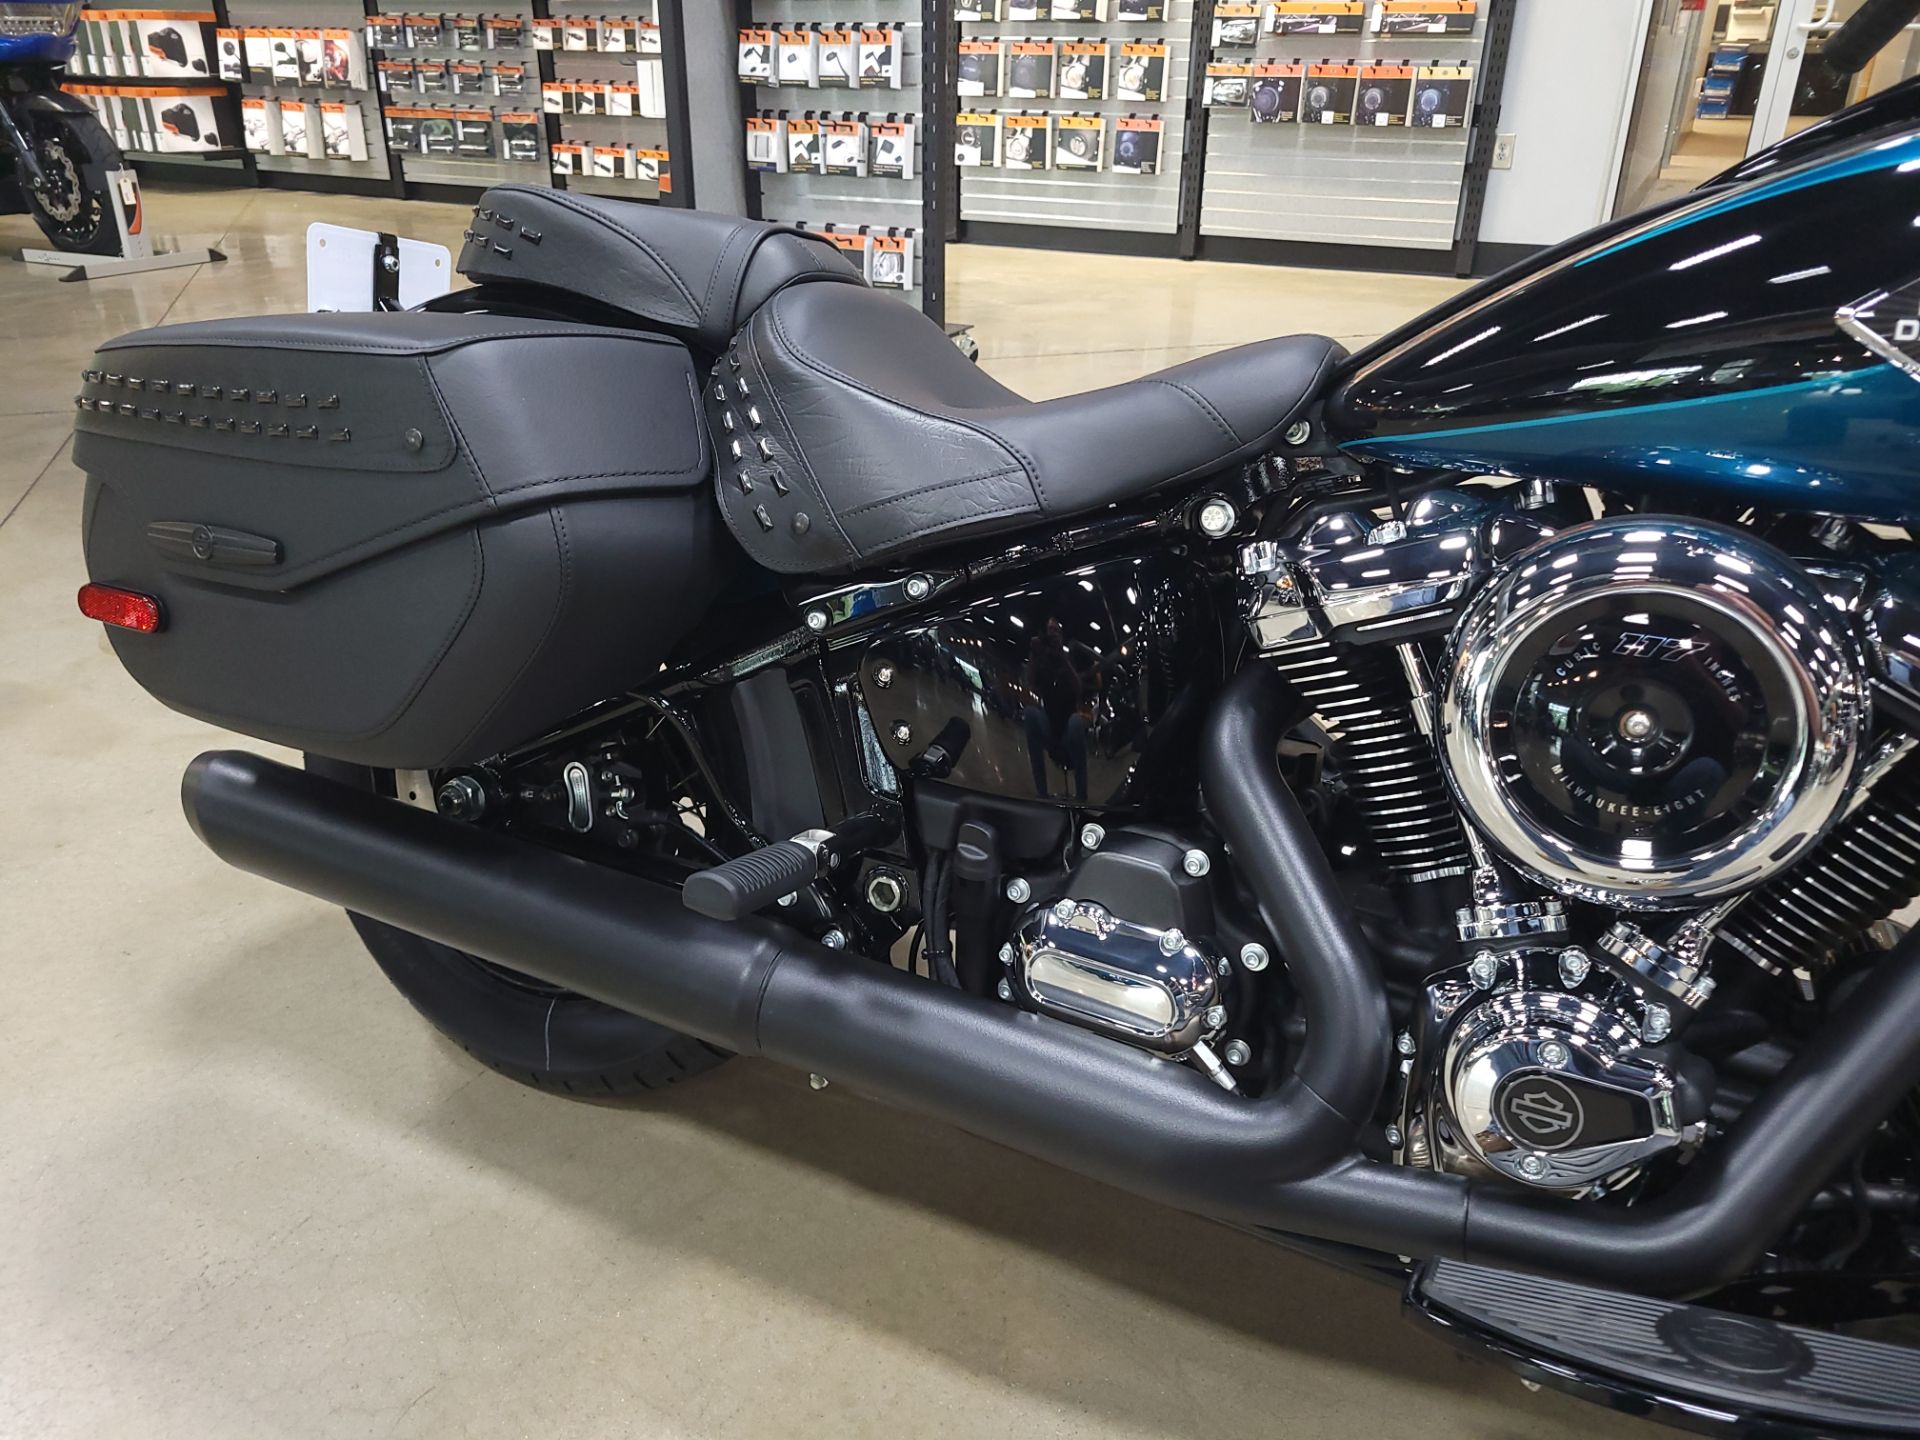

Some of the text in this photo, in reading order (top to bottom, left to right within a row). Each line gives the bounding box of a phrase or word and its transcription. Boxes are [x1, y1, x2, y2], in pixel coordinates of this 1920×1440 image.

[1894, 319, 1920, 341] D
[1555, 632, 1741, 702] CUBIC 117 INCHES
[1551, 764, 1706, 816] MILWAUKEE-EIGHT
